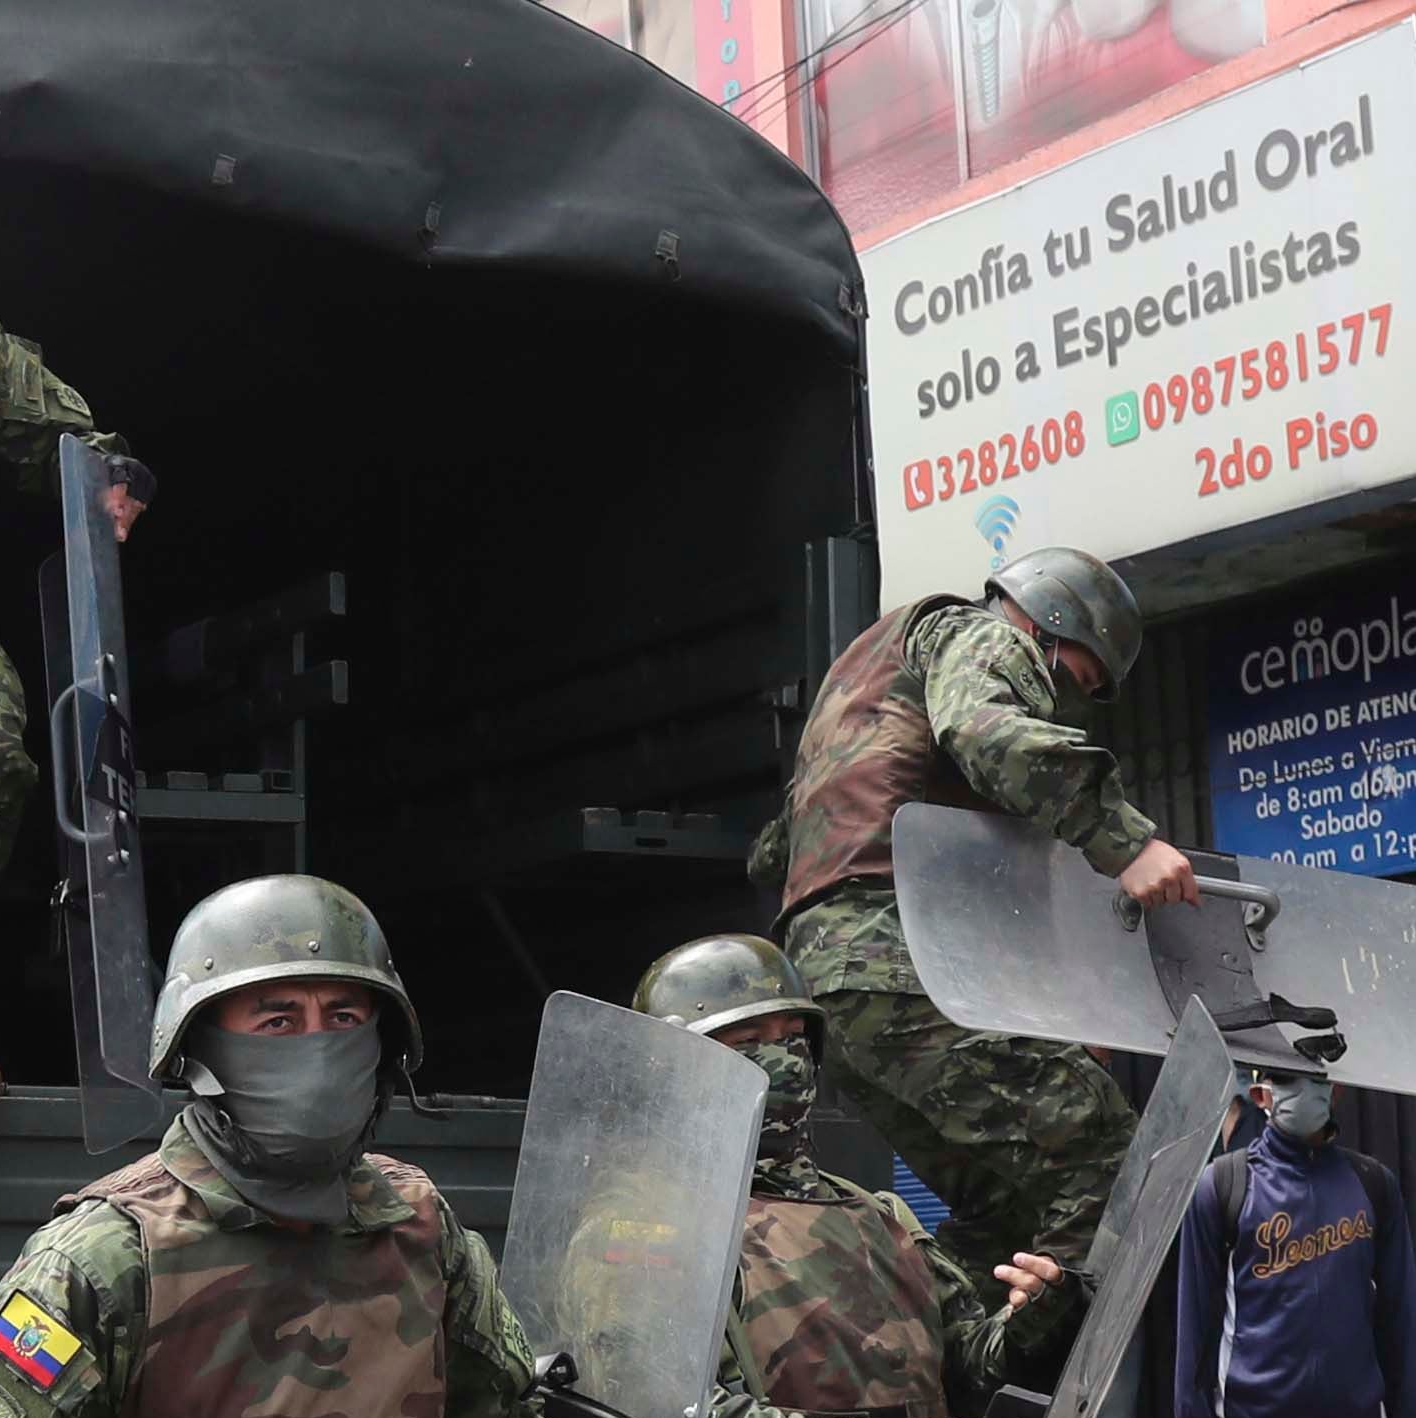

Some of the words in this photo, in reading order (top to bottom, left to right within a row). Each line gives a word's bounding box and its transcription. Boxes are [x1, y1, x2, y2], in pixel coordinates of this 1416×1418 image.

[893, 243, 1033, 335] Confía
[1043, 225, 1092, 280] tu
[1104, 149, 1238, 254] Salud
[1253, 94, 1375, 192] Oral
[916, 349, 1002, 418] solo
[1014, 341, 1040, 385] a
[1053, 219, 1361, 368] Especialistas
[937, 410, 1087, 501] 3282608
[1142, 303, 1394, 431] 0987581577
[1194, 442, 1273, 498] 2do
[1286, 411, 1379, 470] Piso
[1227, 713, 1319, 756] HORARIO
[1325, 705, 1352, 732] DE
[1238, 767, 1268, 793] De
[1273, 755, 1335, 785] Lunes
[1340, 751, 1356, 770] a
[1255, 791, 1281, 820] de
[1286, 784, 1344, 813] 8:am
[1300, 801, 1383, 840] Sabado
[1350, 843, 1366, 863] a
[1251, 1209, 1375, 1279] Leones
